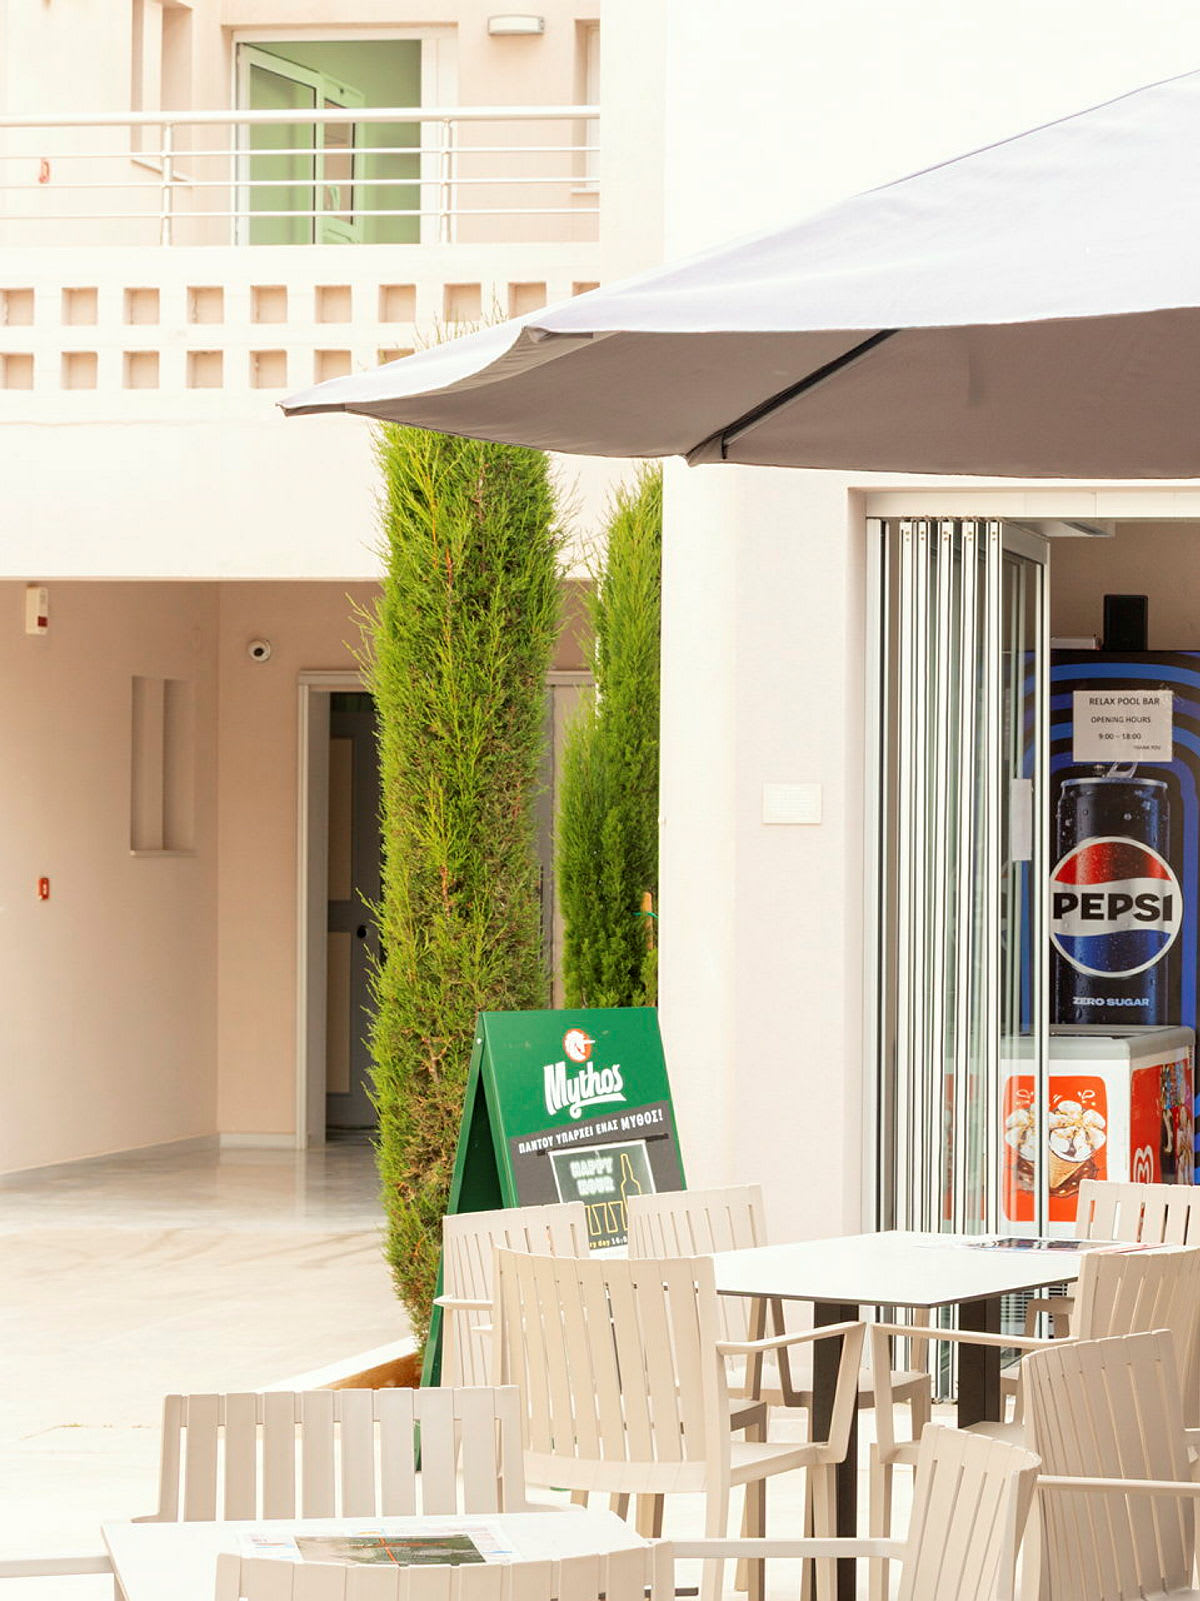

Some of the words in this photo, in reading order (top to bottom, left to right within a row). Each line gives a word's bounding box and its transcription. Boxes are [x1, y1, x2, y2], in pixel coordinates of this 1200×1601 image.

[1089, 697, 1115, 705] RELAX
[1117, 697, 1141, 705] POOL
[1143, 697, 1160, 706] BAR
[1053, 892, 1173, 922] PEPSI
[1072, 996, 1105, 1007] ZERO
[1105, 997, 1150, 1007] SUGAR
[543, 1060, 627, 1119] Mythos
[518, 1136, 554, 1154] ΠΑΝΤΟΥ
[556, 1126, 594, 1145] ΥΠΑΡΧΕΙ
[596, 1120, 618, 1134] ΕΝΑΣ
[620, 1108, 664, 1131] ΜΥΘΟΣ!
[570, 1156, 614, 1178] HAPPY
[576, 1176, 615, 1197] HOUR
